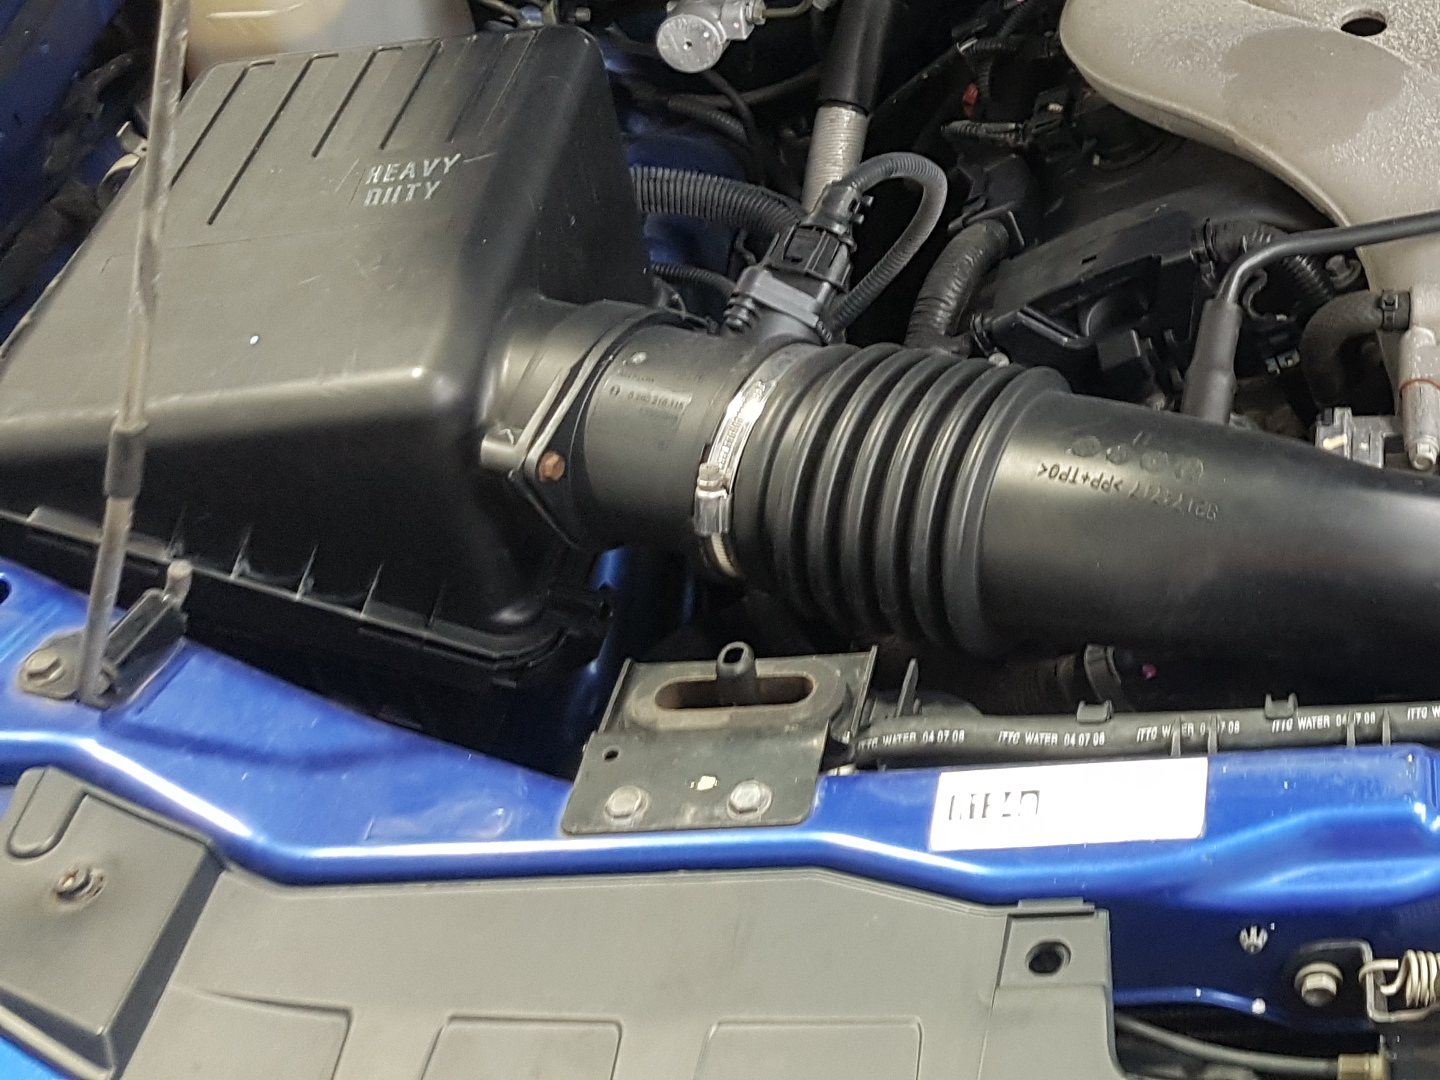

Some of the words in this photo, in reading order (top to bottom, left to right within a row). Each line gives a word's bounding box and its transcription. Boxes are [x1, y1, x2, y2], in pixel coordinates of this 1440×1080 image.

[364, 152, 462, 186] HEAVY
[363, 180, 442, 207] DUTY
[1228, 720, 1240, 734] 08
[1297, 714, 1330, 731] WATER
[882, 731, 917, 746] WATER
[922, 730, 934, 744] 04
[937, 729, 949, 742] 07
[952, 729, 965, 743] 08
[1025, 731, 1059, 746] WATER
[1063, 733, 1076, 747] 04
[1078, 732, 1091, 746] 07
[1093, 731, 1105, 746] 08
